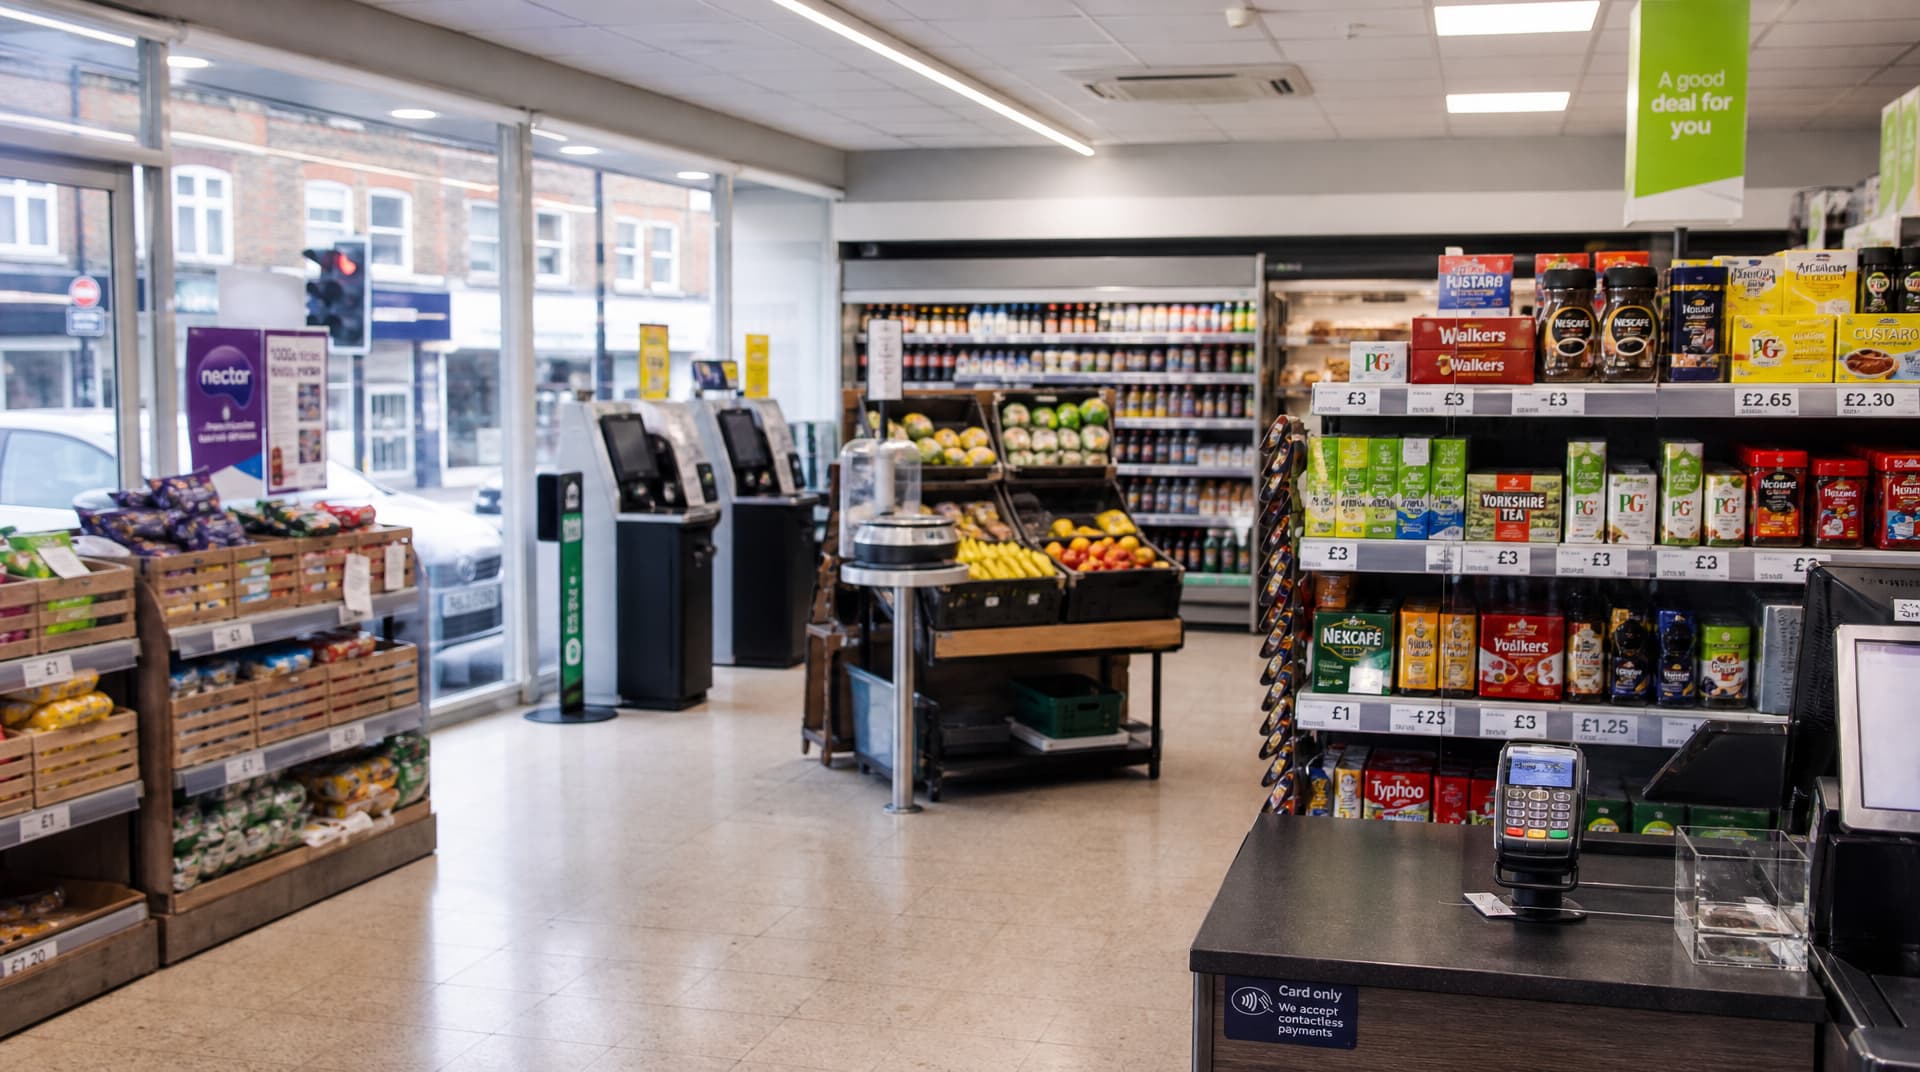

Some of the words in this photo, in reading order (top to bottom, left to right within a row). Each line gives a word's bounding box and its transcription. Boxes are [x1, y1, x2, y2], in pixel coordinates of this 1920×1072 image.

[1658, 72, 1672, 88] A
[1677, 70, 1725, 92] good
[1651, 93, 1697, 112] deal
[1702, 92, 1732, 111] for
[1671, 119, 1711, 139] you
[1439, 327, 1506, 345] Walkers
[1365, 353, 1390, 372] PG
[1451, 358, 1504, 371] Walkers
[201, 367, 250, 385] nectar
[1347, 392, 1366, 405] £3
[1445, 392, 1464, 406] £3
[1742, 393, 1792, 407] £2.65
[1844, 393, 1895, 407] £2.30
[1482, 494, 1545, 509] YORKSHIRE
[1576, 500, 1594, 515] PG
[1619, 494, 1645, 513] PG
[1672, 501, 1690, 516] PG
[1715, 498, 1738, 514] PG
[1502, 509, 1524, 521] TEA
[1328, 546, 1348, 560] £3
[1497, 551, 1518, 565] £3
[1592, 552, 1611, 566] £3
[1695, 555, 1718, 570] £3
[1332, 706, 1350, 720] £1
[1514, 715, 1536, 729] £3
[1582, 719, 1628, 734] £1.25
[1371, 780, 1424, 800] Typhoo
[41, 813, 55, 829] £1
[1279, 985, 1310, 998] Card
[1313, 988, 1342, 1003] only
[1278, 1003, 1297, 1013] We
[1300, 1005, 1339, 1018] accept
[1278, 1015, 1344, 1028] contactless
[1278, 1025, 1333, 1038] payments
